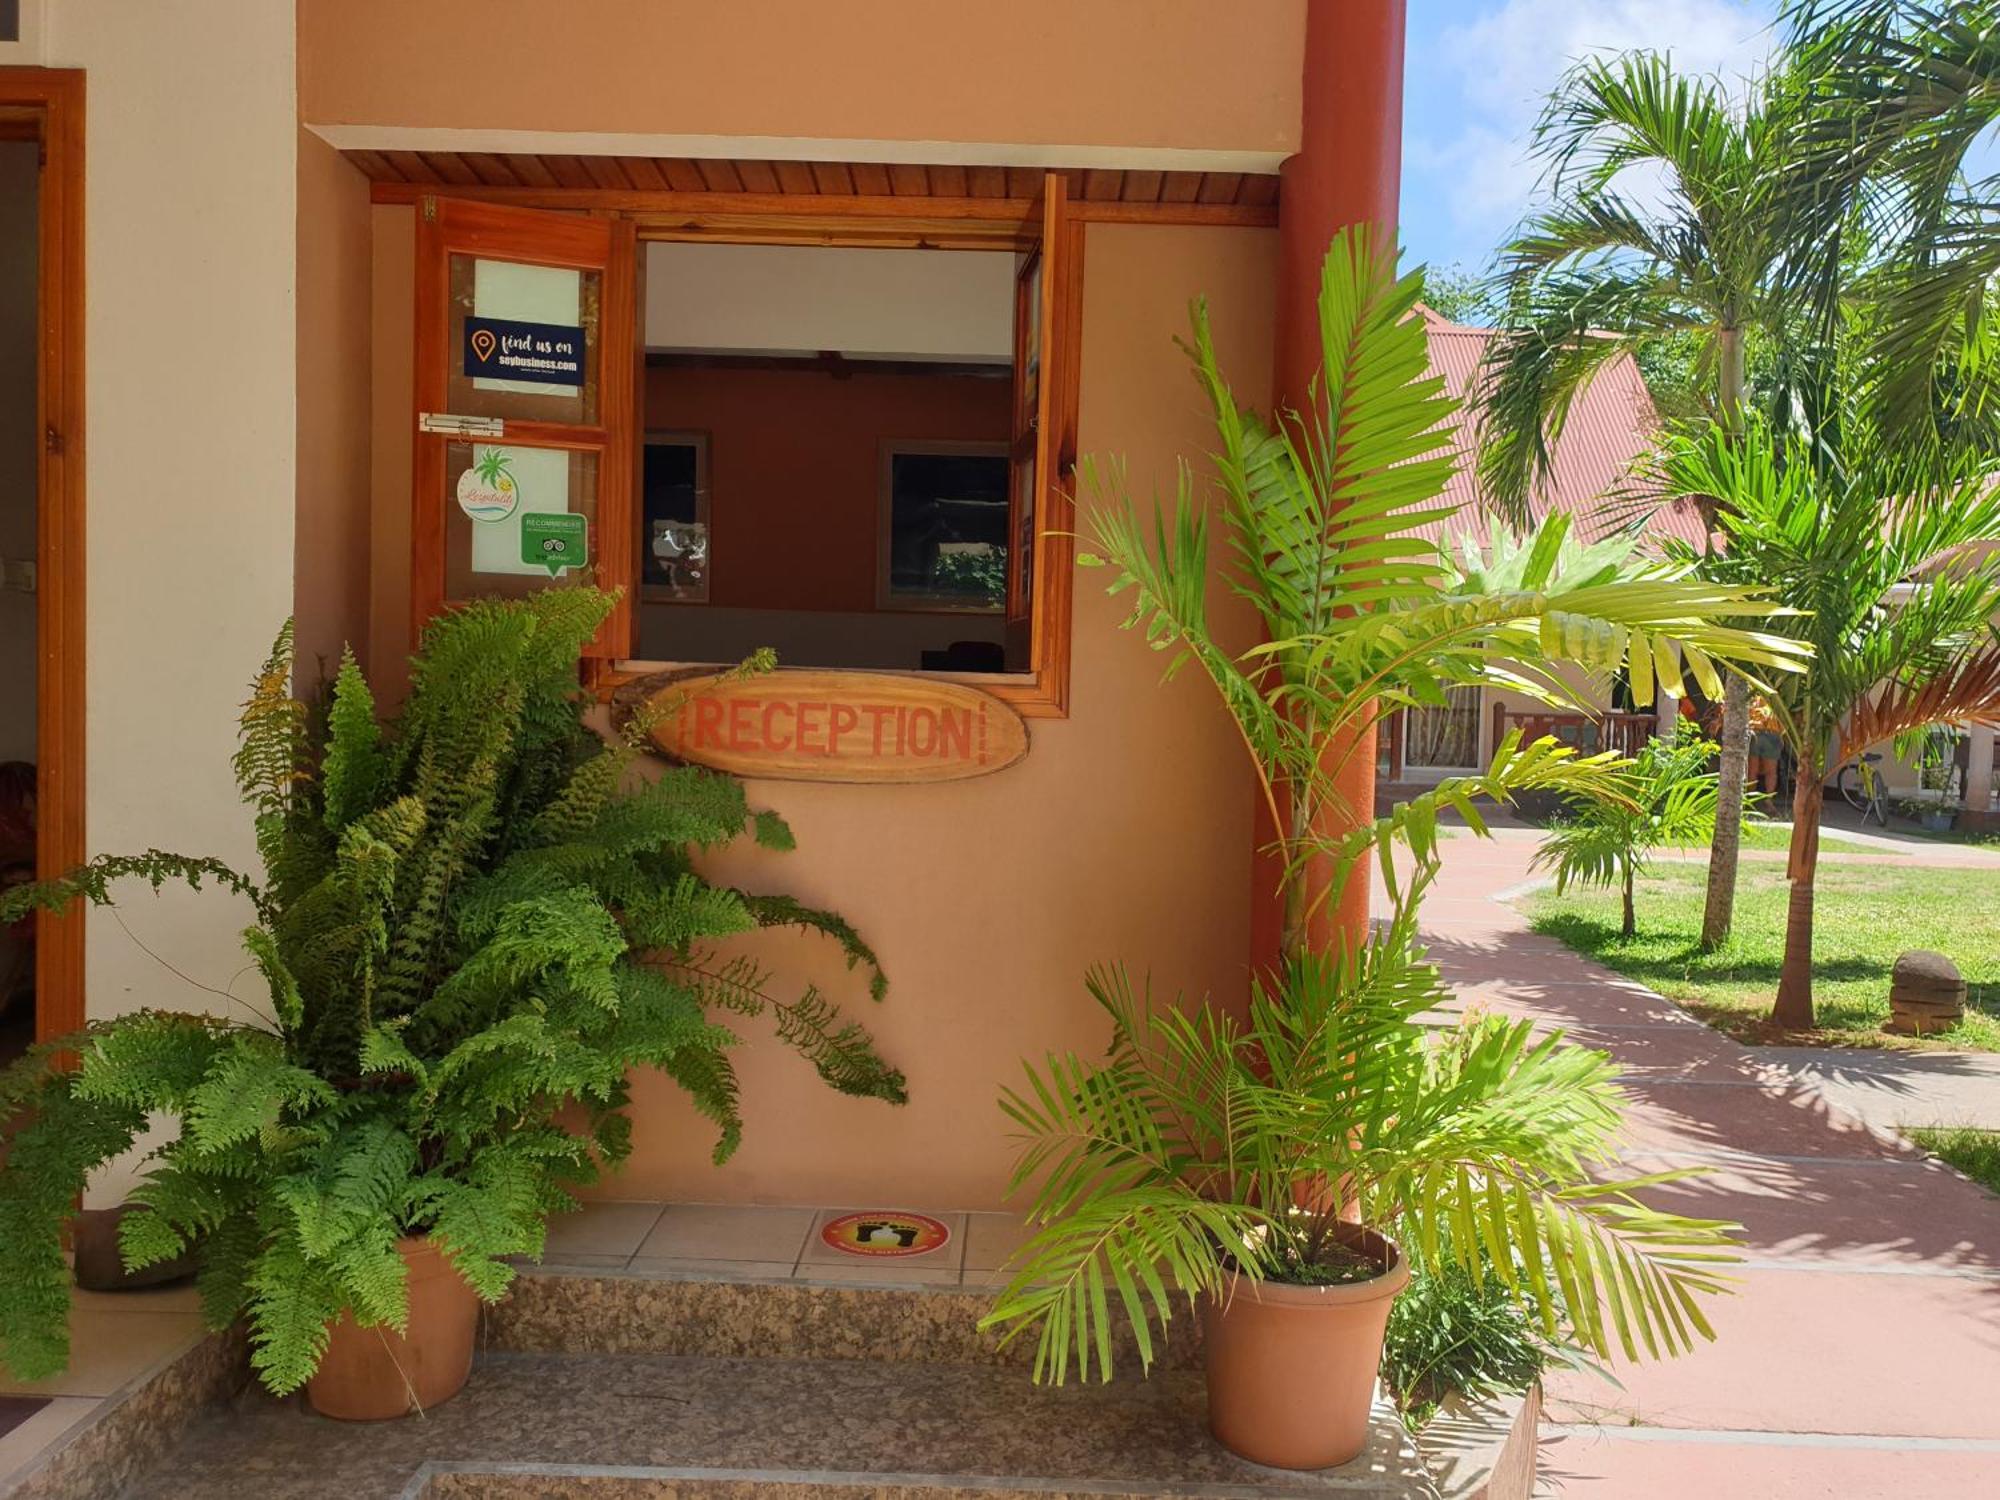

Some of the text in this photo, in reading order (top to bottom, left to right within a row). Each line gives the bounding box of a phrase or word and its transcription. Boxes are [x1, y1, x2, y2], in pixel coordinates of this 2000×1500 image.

[502, 334, 572, 355] find us on
